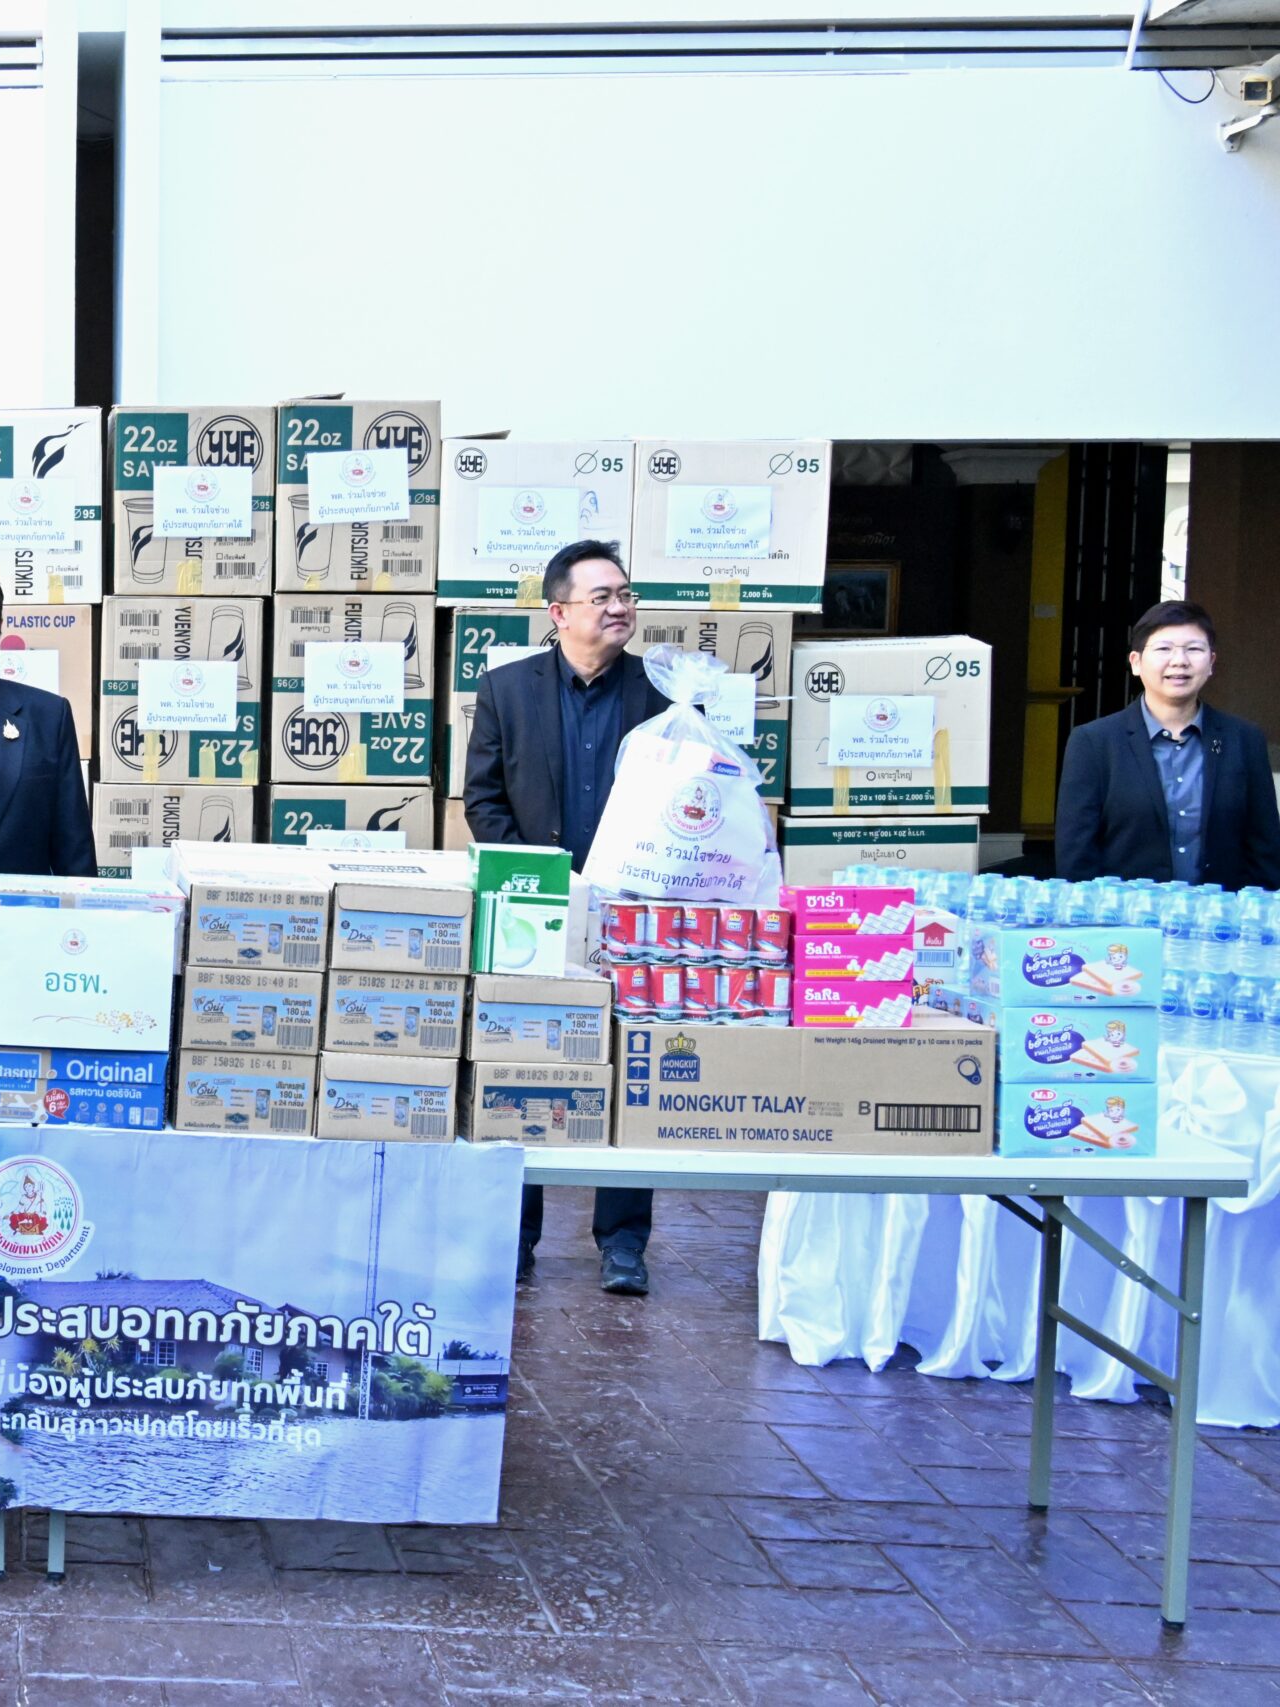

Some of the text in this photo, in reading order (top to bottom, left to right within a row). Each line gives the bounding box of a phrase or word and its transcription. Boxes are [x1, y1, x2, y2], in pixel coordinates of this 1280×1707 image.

[123, 425, 177, 452] 22oz
[287, 419, 341, 446] 22oz
[7, 616, 75, 628] PLASTIC CUP
[371, 712, 426, 728] SAVE
[371, 737, 425, 764] 22oz
[875, 793, 886, 801] 100
[906, 793, 923, 801] 2,000
[806, 892, 844, 907] ซาร่า
[434, 930, 447, 938] 180
[805, 942, 841, 954] SaRa
[45, 972, 108, 994] อธพ.
[198, 973, 214, 983] BBF
[337, 976, 353, 985] BBF
[805, 989, 840, 1000] SaRa
[192, 1056, 207, 1065] BBF
[663, 1060, 697, 1069] MONGKUT
[66, 1059, 153, 1086] Original
[494, 1069, 510, 1079] BBF
[663, 1070, 695, 1079] TALAY
[659, 1095, 746, 1112] MONGKUT
[752, 1096, 806, 1113] TALAY
[858, 1101, 870, 1115] B
[658, 1127, 833, 1141] MACKEREL IN TOMATO SAUCE
[46, 1226, 90, 1271] Department
